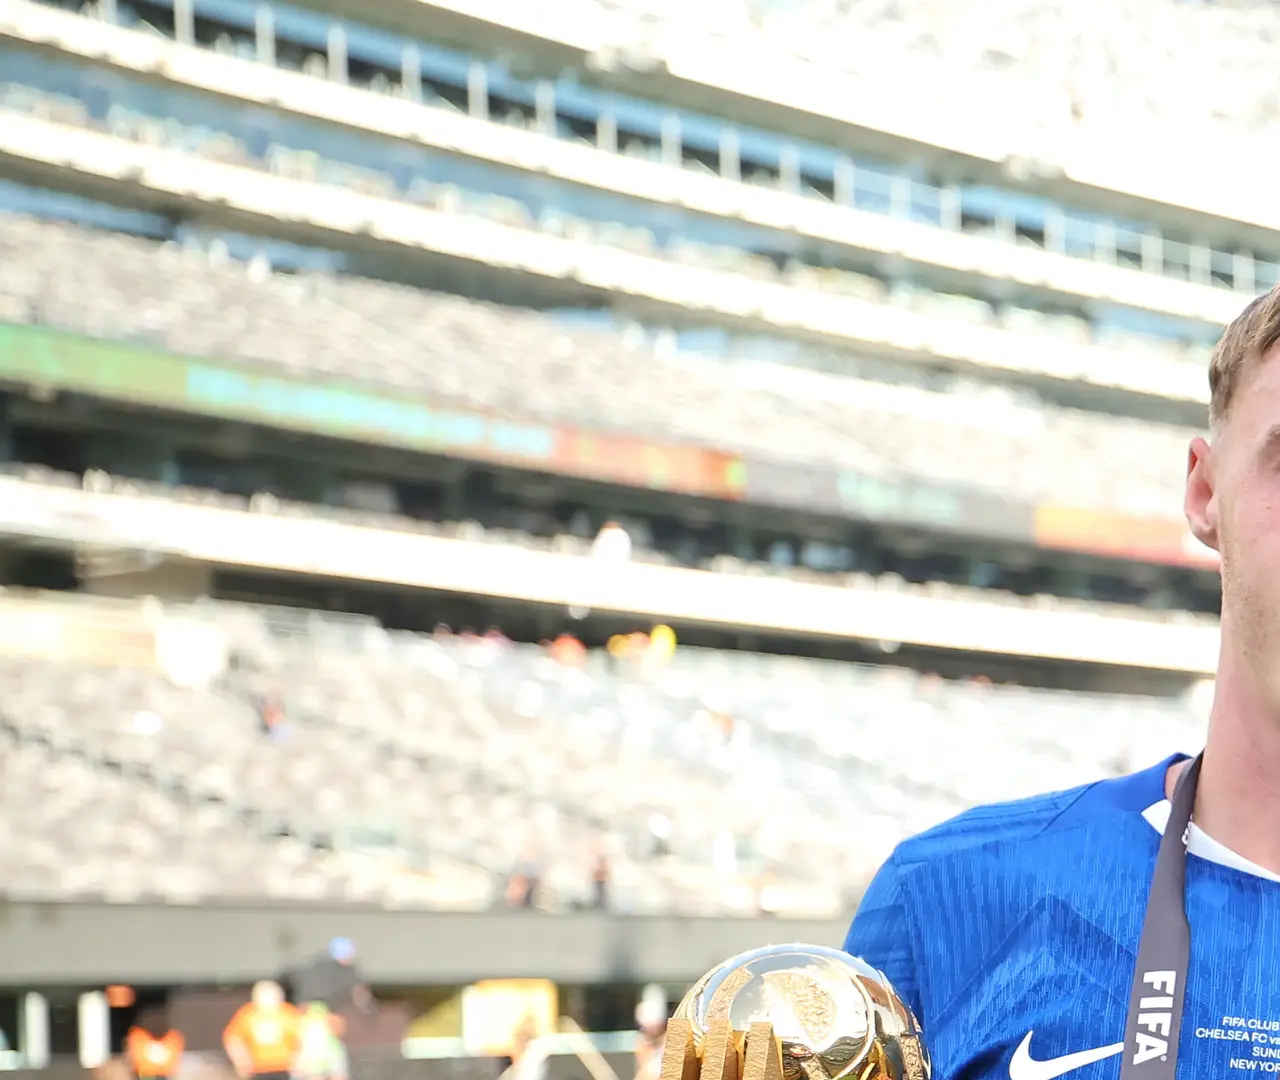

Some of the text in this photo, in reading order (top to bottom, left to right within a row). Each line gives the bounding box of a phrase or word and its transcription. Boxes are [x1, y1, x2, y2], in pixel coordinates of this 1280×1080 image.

[1133, 970, 1176, 1065] FIFA
[1222, 1016, 1247, 1027] FIFA
[1248, 1019, 1280, 1031] CLUB
[1195, 1028, 1250, 1042] CHELSEA
[1252, 1033, 1268, 1043] FC
[1269, 1036, 1280, 1045] vs
[1229, 1058, 1257, 1070] NEW
